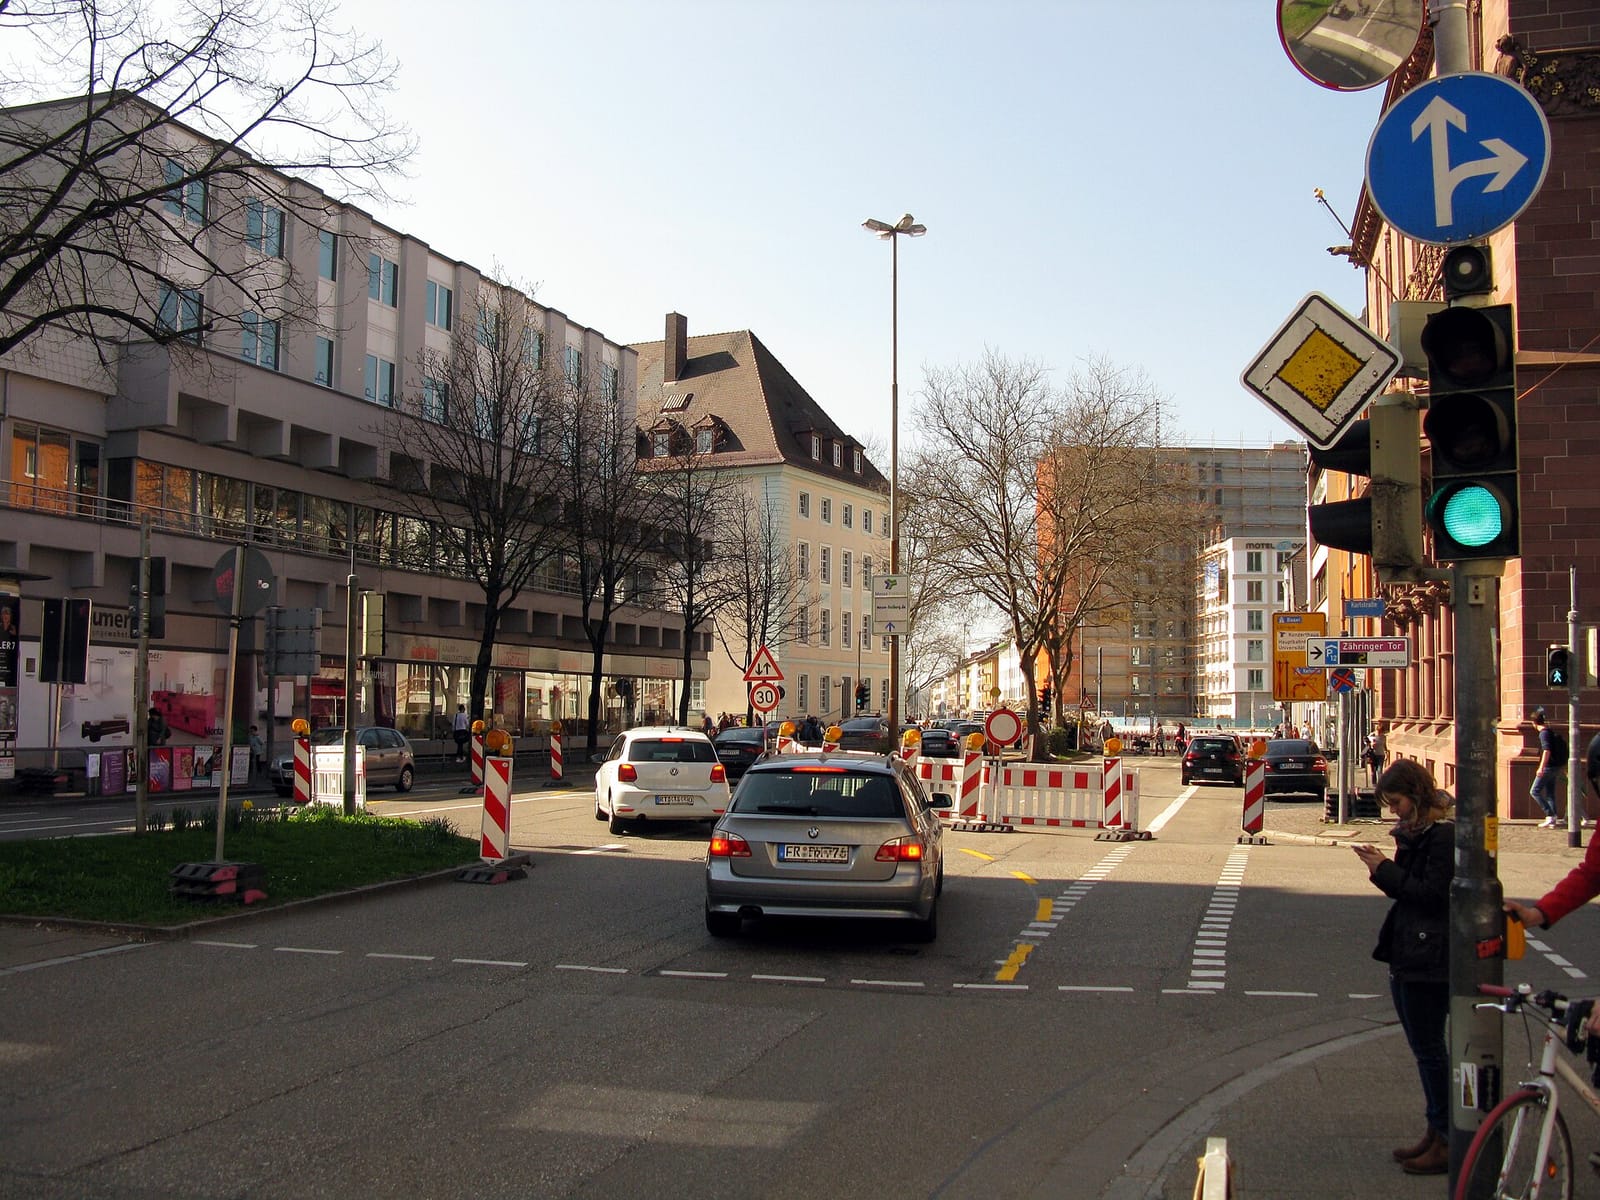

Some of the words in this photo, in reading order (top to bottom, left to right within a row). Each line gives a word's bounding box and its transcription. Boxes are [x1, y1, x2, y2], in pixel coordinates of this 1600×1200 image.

[1342, 641, 1384, 651] Zähringer
[1387, 641, 1402, 650] Tor
[1330, 654, 1337, 662] 12
[1358, 653, 1366, 664] 2
[756, 690, 773, 704] 30
